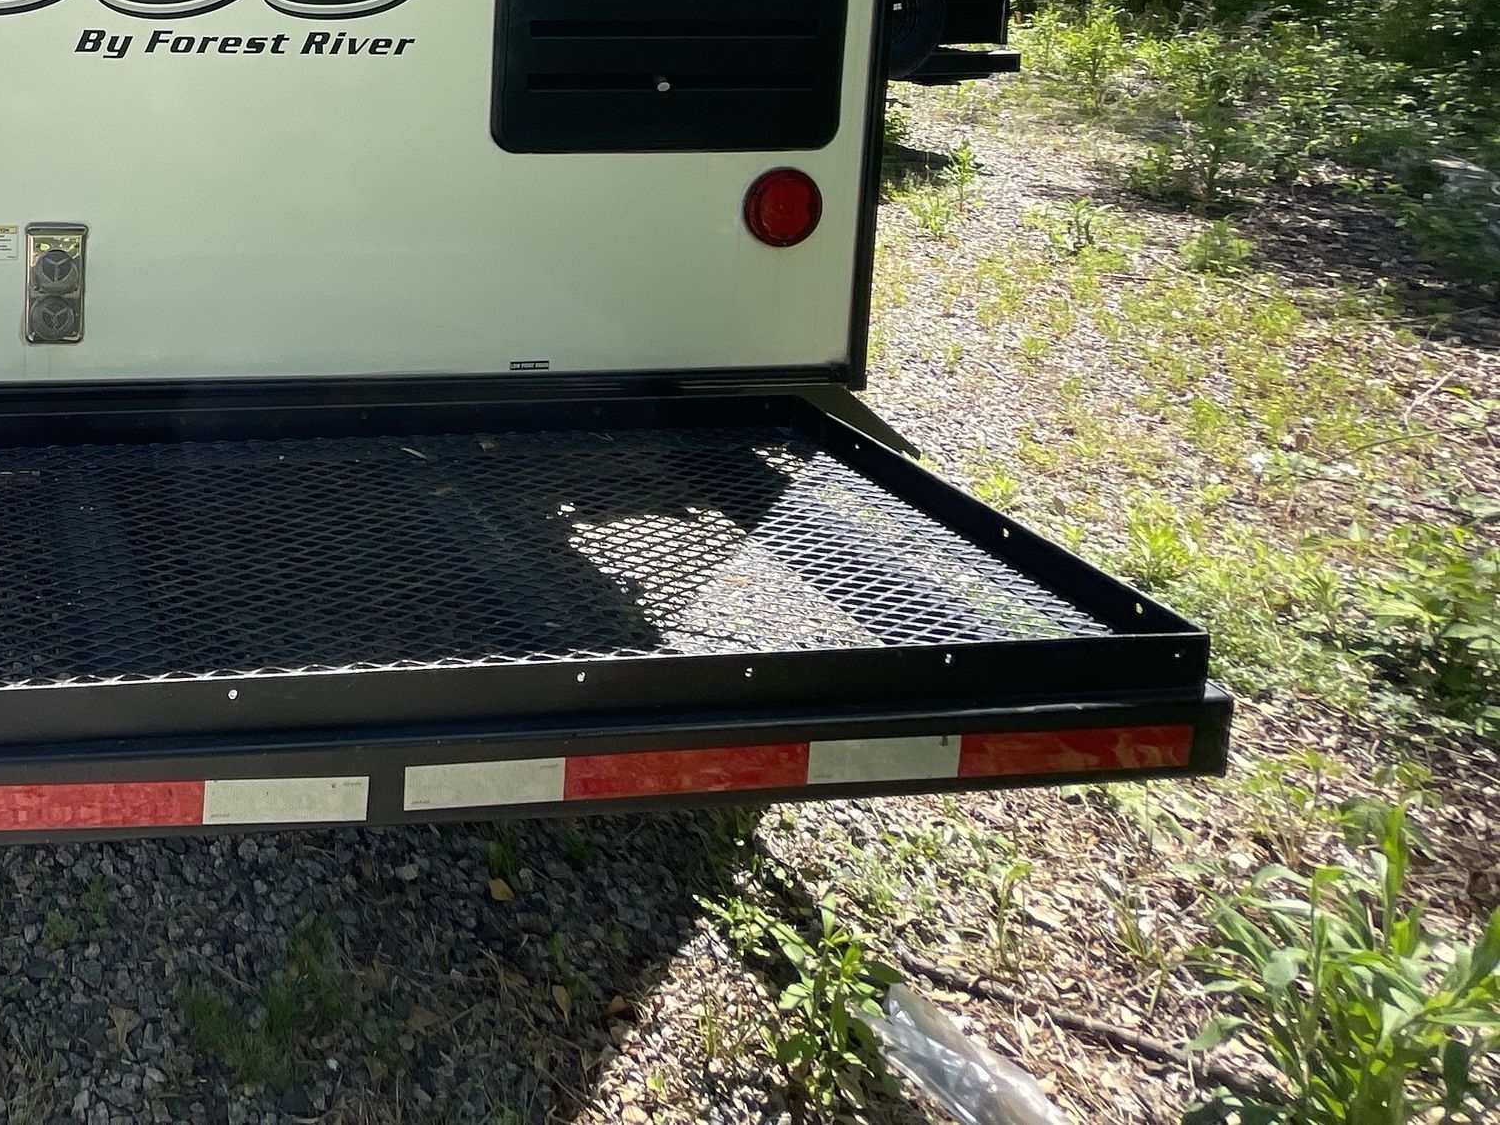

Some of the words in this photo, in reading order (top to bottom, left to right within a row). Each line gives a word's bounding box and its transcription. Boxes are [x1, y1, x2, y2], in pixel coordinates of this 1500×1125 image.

[75, 29, 133, 58] By
[144, 30, 290, 54] Forest
[300, 32, 416, 55] River
